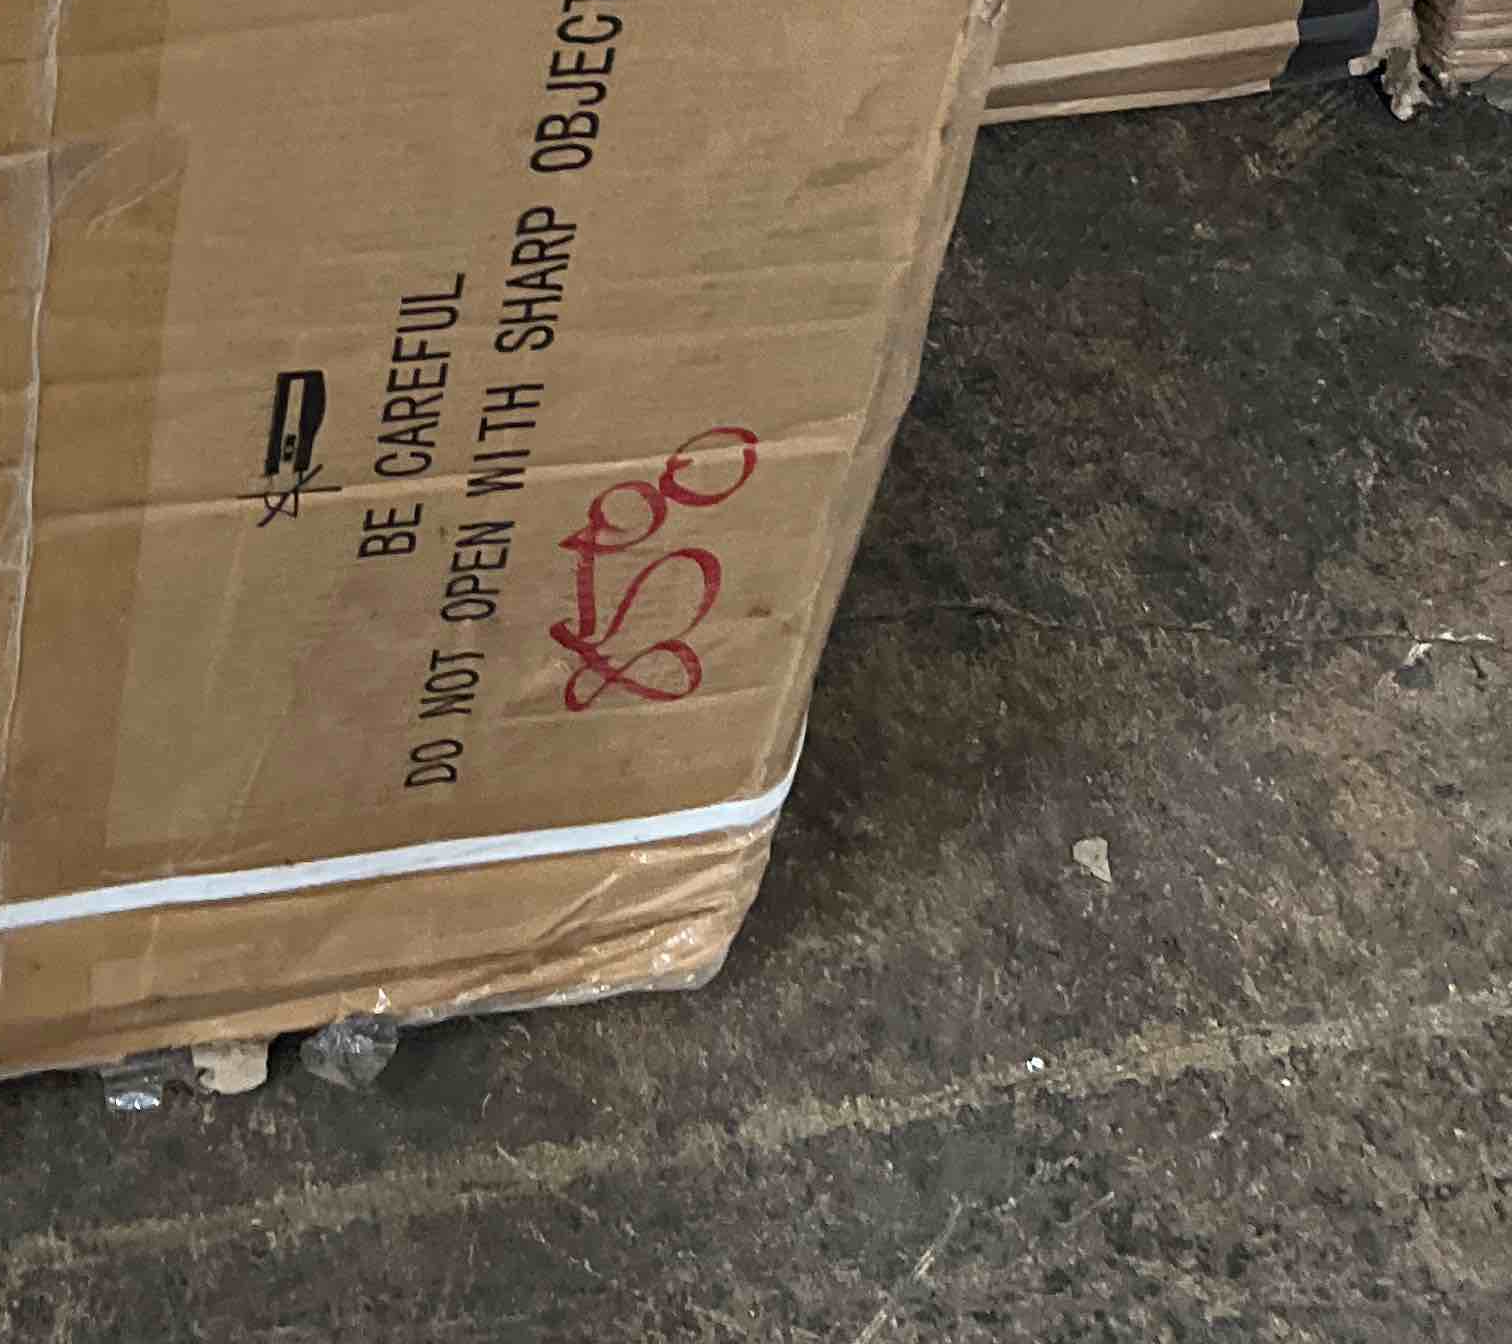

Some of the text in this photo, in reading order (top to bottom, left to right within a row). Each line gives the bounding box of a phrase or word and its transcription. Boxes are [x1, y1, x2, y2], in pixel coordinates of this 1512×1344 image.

[494, 205, 577, 353] SHARP
[356, 271, 466, 560] BE CAREFUL
[466, 383, 545, 497] WITH
[440, 519, 515, 623] OPEN
[419, 649, 485, 718] NOT
[403, 739, 464, 788] DO
